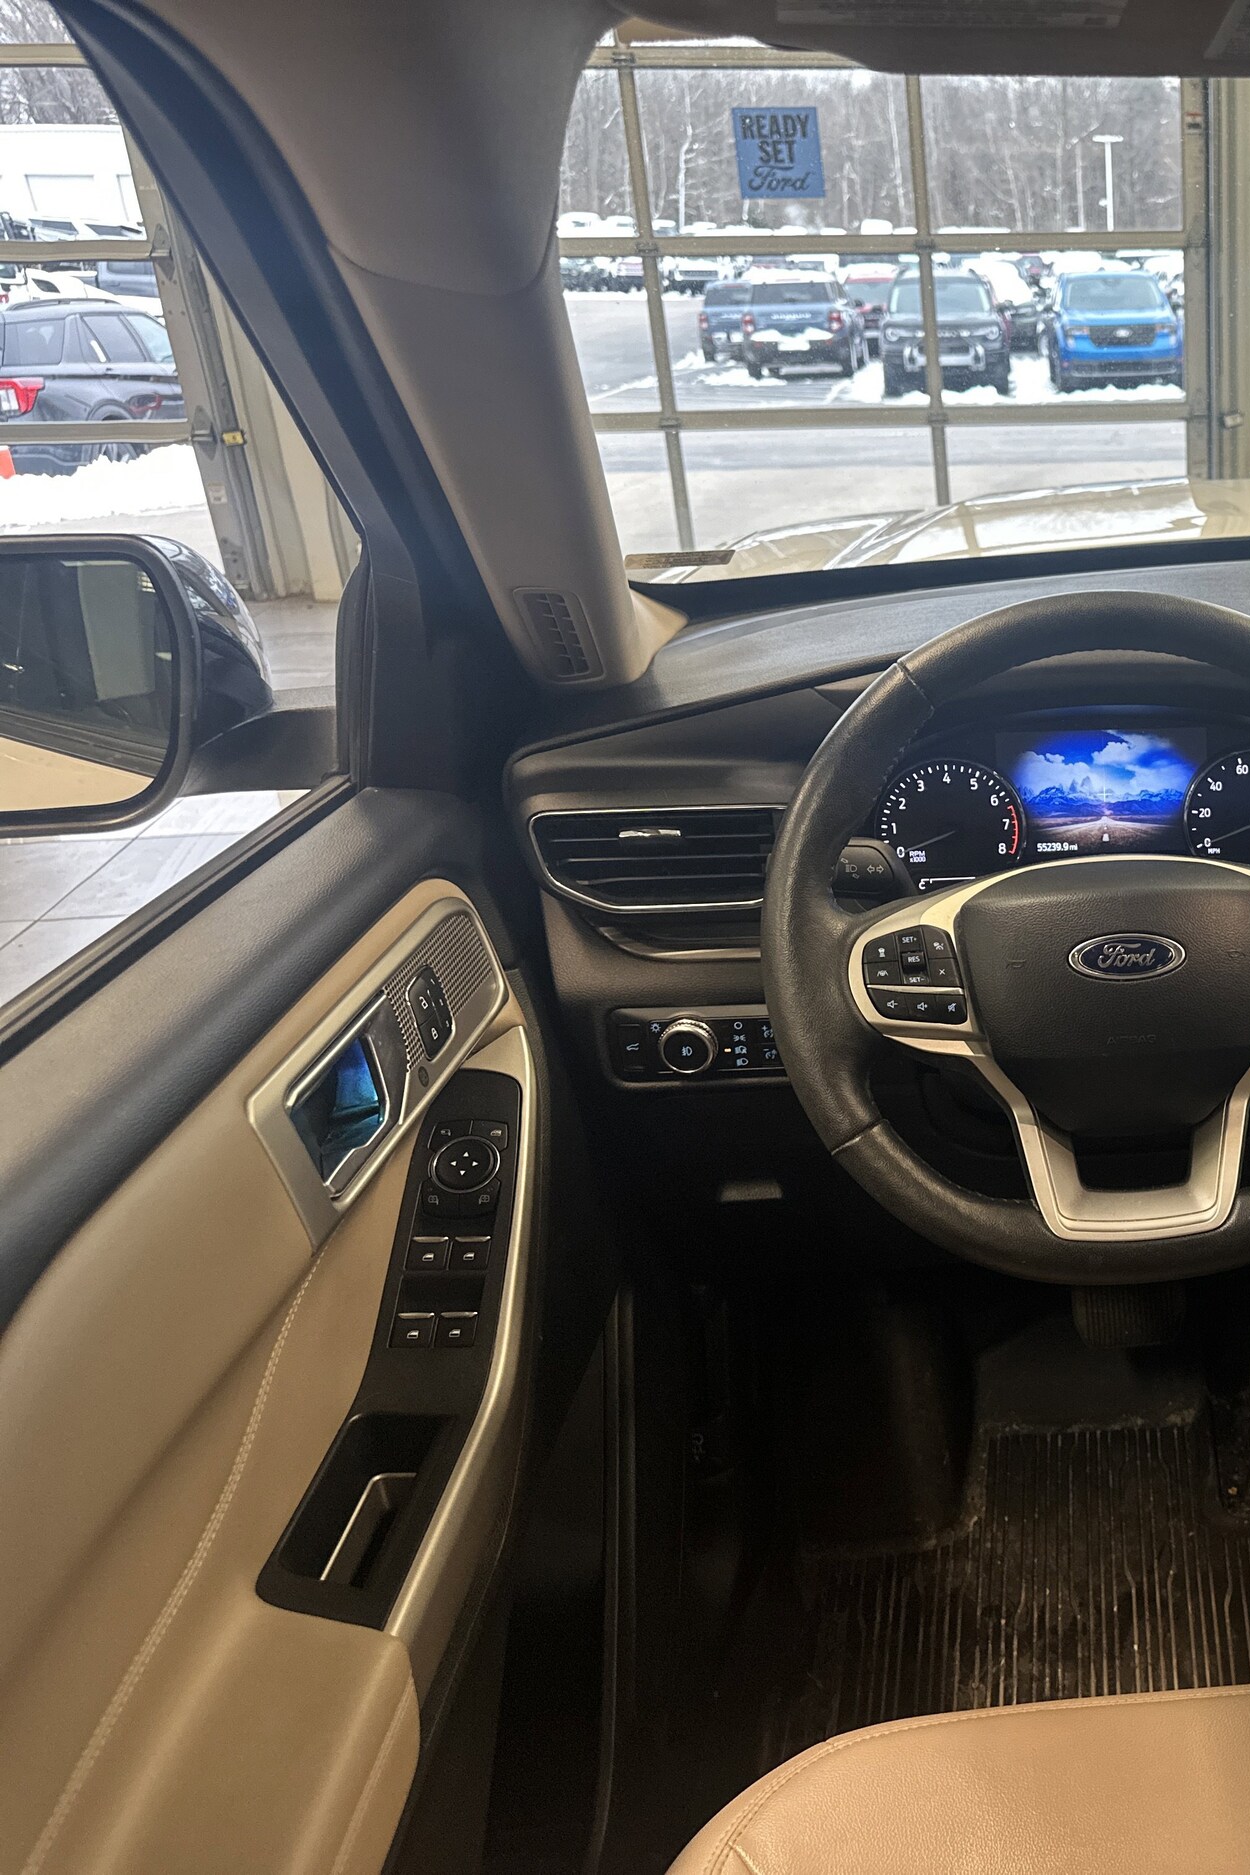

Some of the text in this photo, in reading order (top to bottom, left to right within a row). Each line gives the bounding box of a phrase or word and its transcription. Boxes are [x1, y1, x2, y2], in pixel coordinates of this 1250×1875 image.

[741, 114, 809, 140] READY
[758, 140, 796, 163] SET
[747, 165, 812, 192] Ford
[1235, 764, 1249, 775] 60
[943, 773, 951, 784] 4
[970, 778, 979, 790] 5
[917, 780, 925, 792] 3
[1209, 781, 1223, 792] 40
[898, 798, 907, 810] 2
[990, 794, 999, 806] 6
[1199, 807, 1212, 818] 20
[891, 822, 897, 834] 1
[1002, 819, 1010, 830] 7
[998, 843, 1007, 854] 8
[1036, 842, 1078, 852] 55239.9 mi
[1204, 837, 1211, 848] 0
[896, 846, 905, 858] 0
[1097, 943, 1156, 968] Ford
